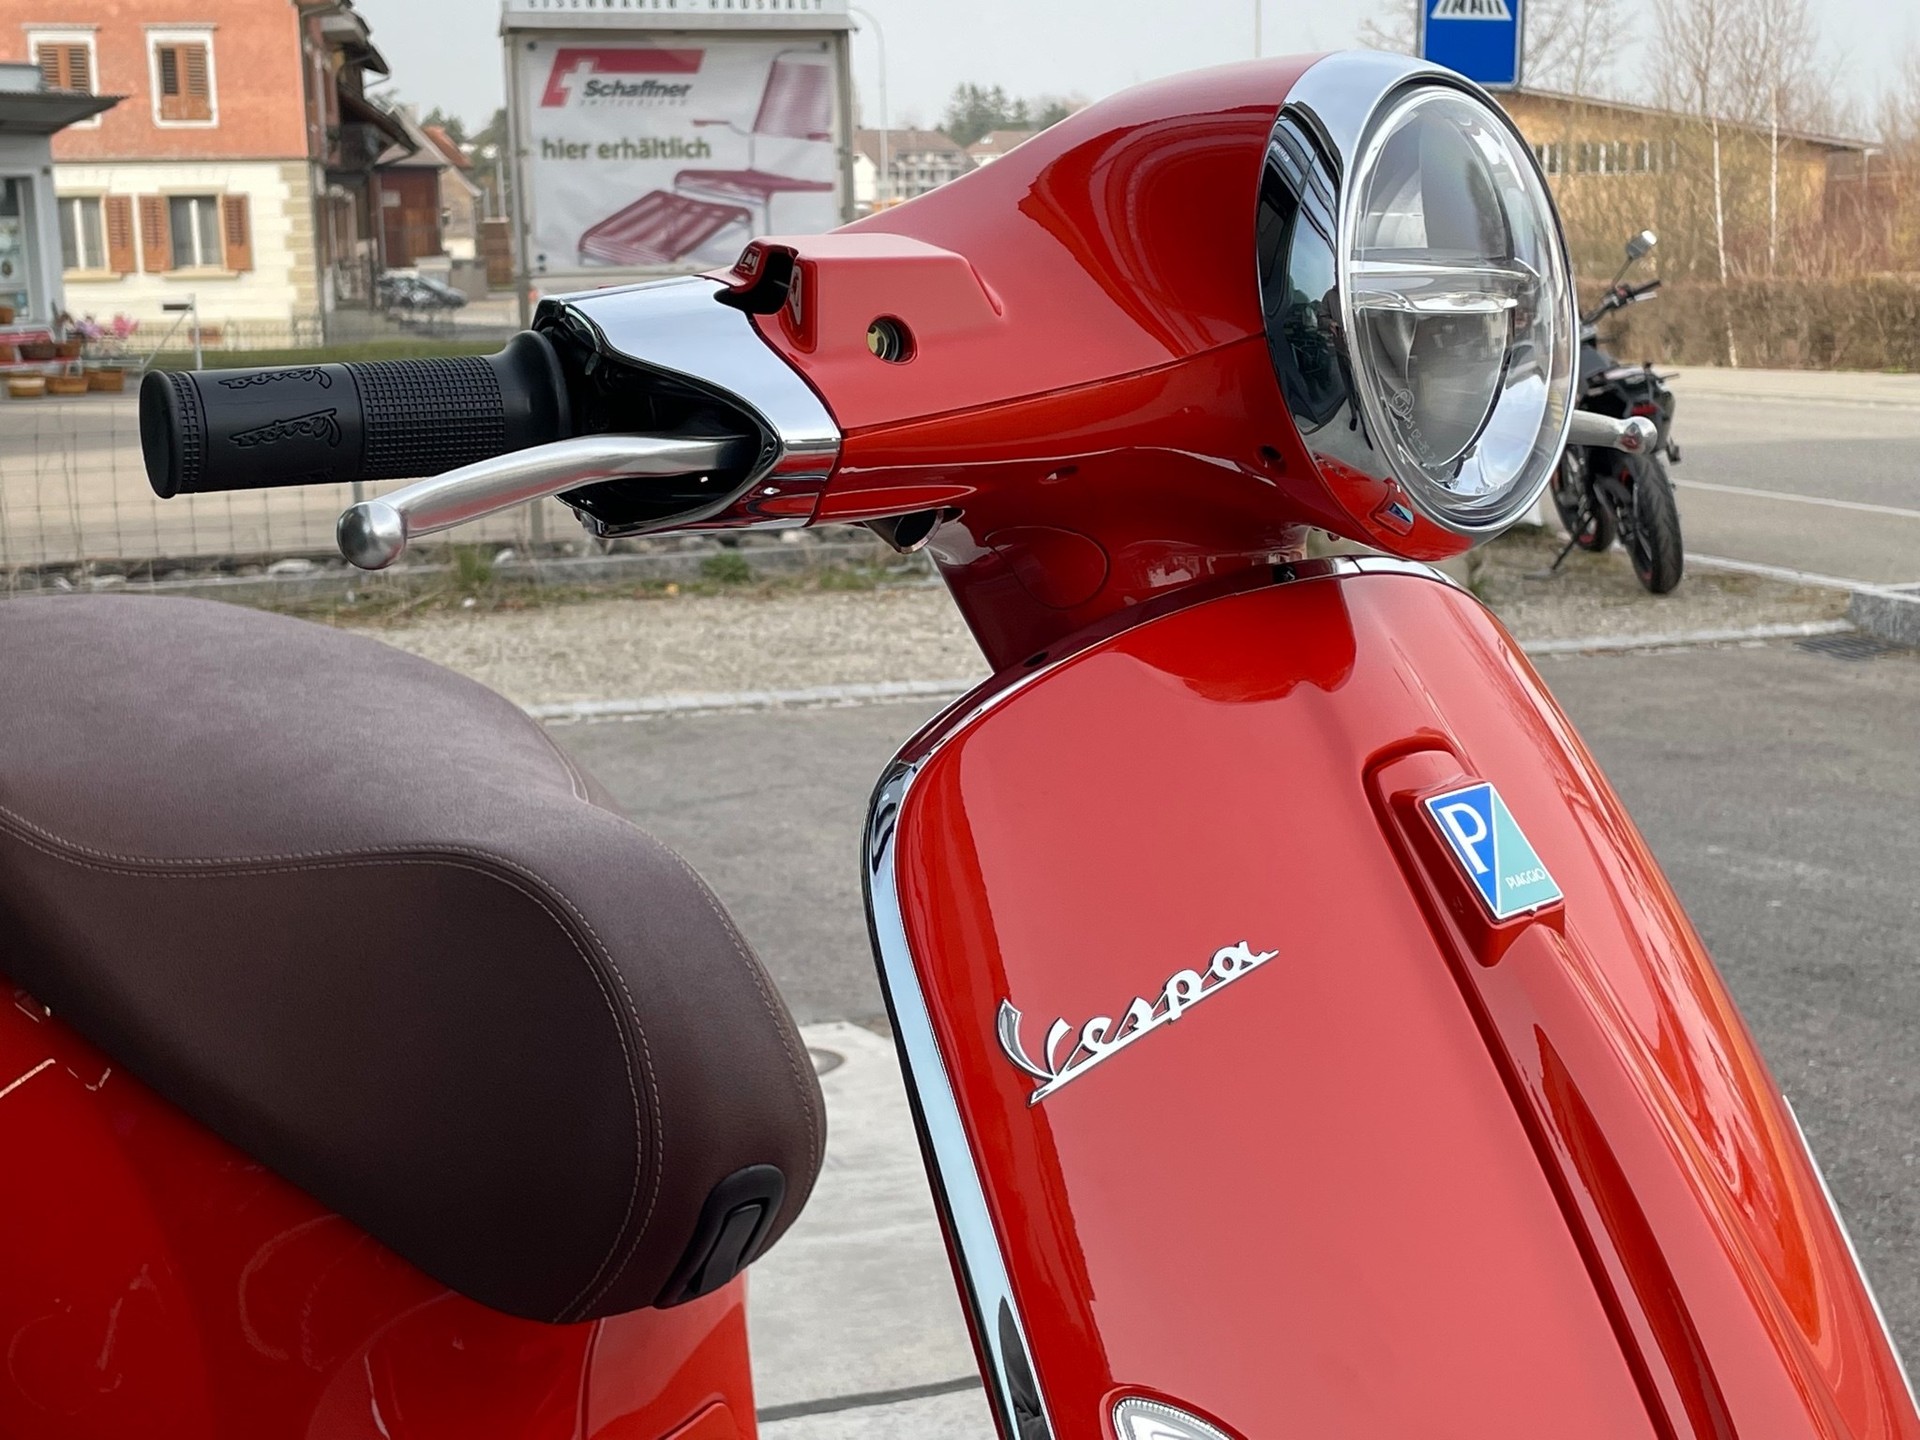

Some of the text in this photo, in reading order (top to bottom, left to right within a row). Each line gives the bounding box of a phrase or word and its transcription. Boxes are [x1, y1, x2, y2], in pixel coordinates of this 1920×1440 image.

[583, 79, 692, 97] Schaffner
[541, 137, 712, 160] hier erhältlich
[218, 366, 332, 389] Vespa
[229, 407, 342, 450] Vespa
[1438, 802, 1490, 874] P
[1505, 868, 1546, 889] PIAGGIO
[997, 939, 1279, 1108] Vespa
